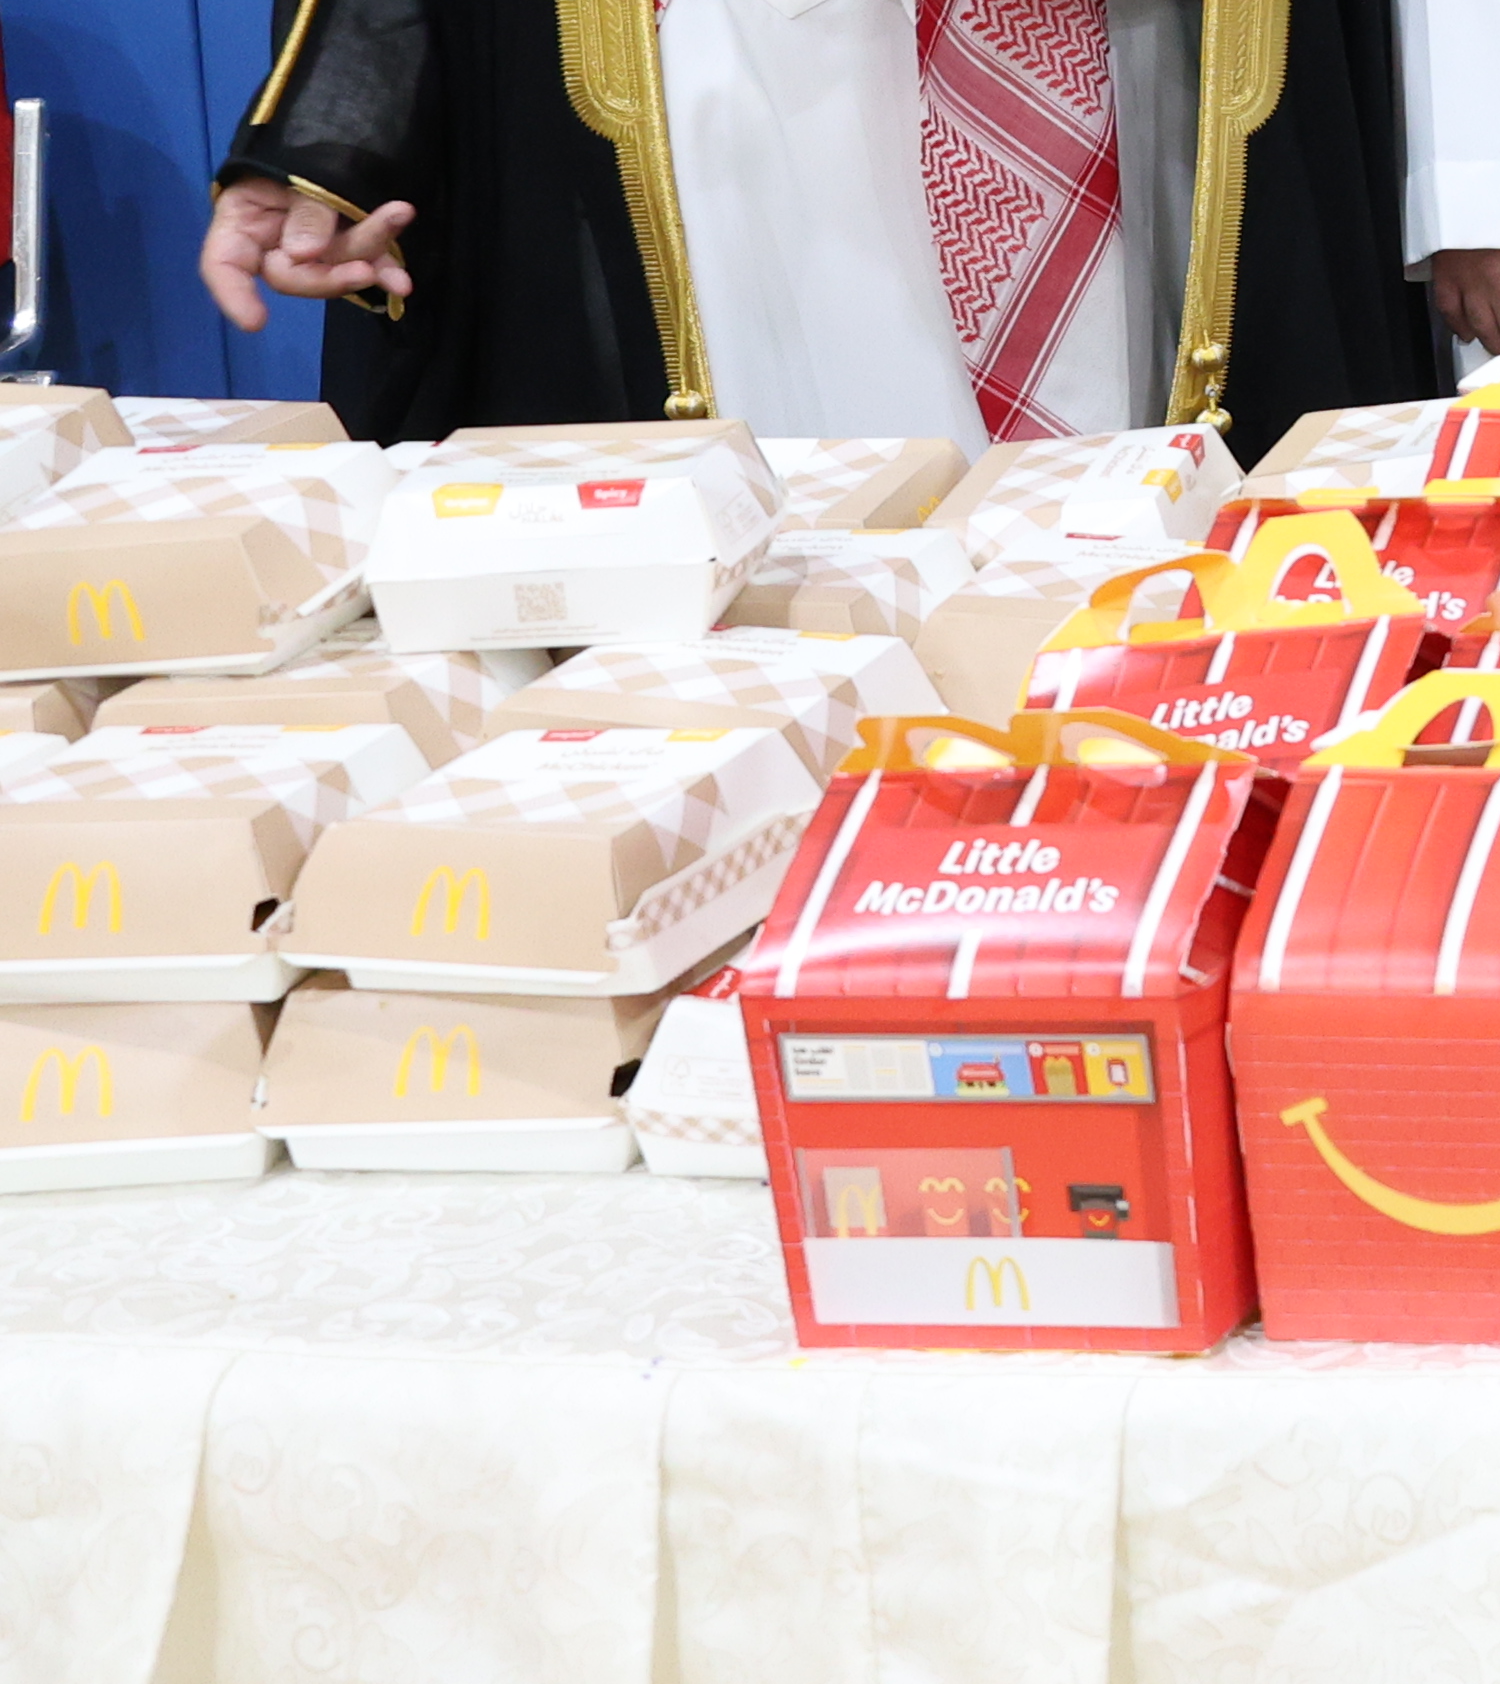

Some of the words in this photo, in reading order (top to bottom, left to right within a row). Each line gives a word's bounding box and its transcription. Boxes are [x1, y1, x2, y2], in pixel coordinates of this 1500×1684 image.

[1150, 691, 1254, 731] Little
[937, 838, 1062, 876] Little
[853, 877, 1120, 916] McDonald's
